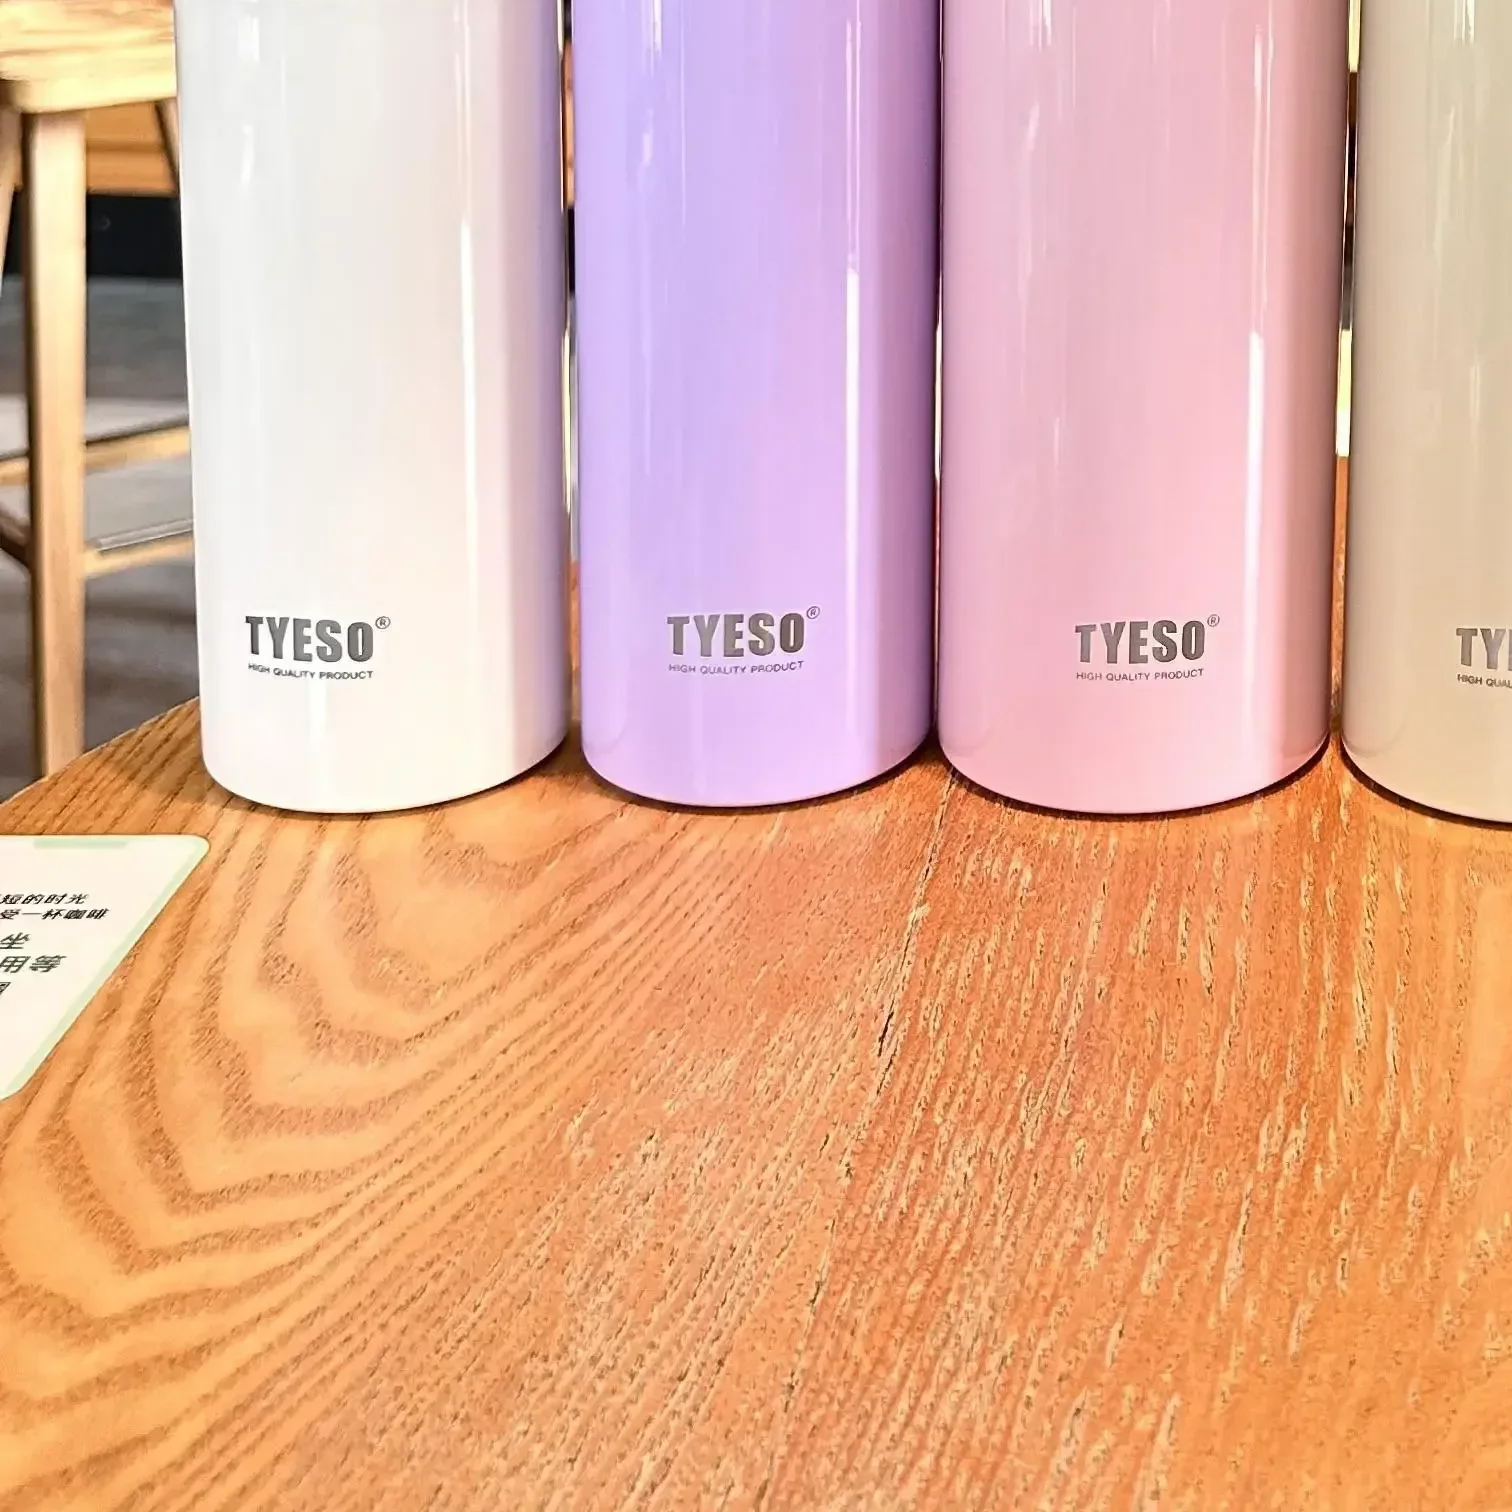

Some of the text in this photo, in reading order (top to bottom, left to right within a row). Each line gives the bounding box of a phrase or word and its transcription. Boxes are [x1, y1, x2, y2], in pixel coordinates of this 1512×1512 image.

[248, 663, 373, 679] HIGH QUALITY PRODUCT
[669, 660, 804, 675] HIGH QUALITY PRODUCT
[1076, 668, 1204, 681] HIGH QUALITY PRODUCT
[1457, 674, 1482, 685] HIGH
[0, 932, 30, 949] 坐
